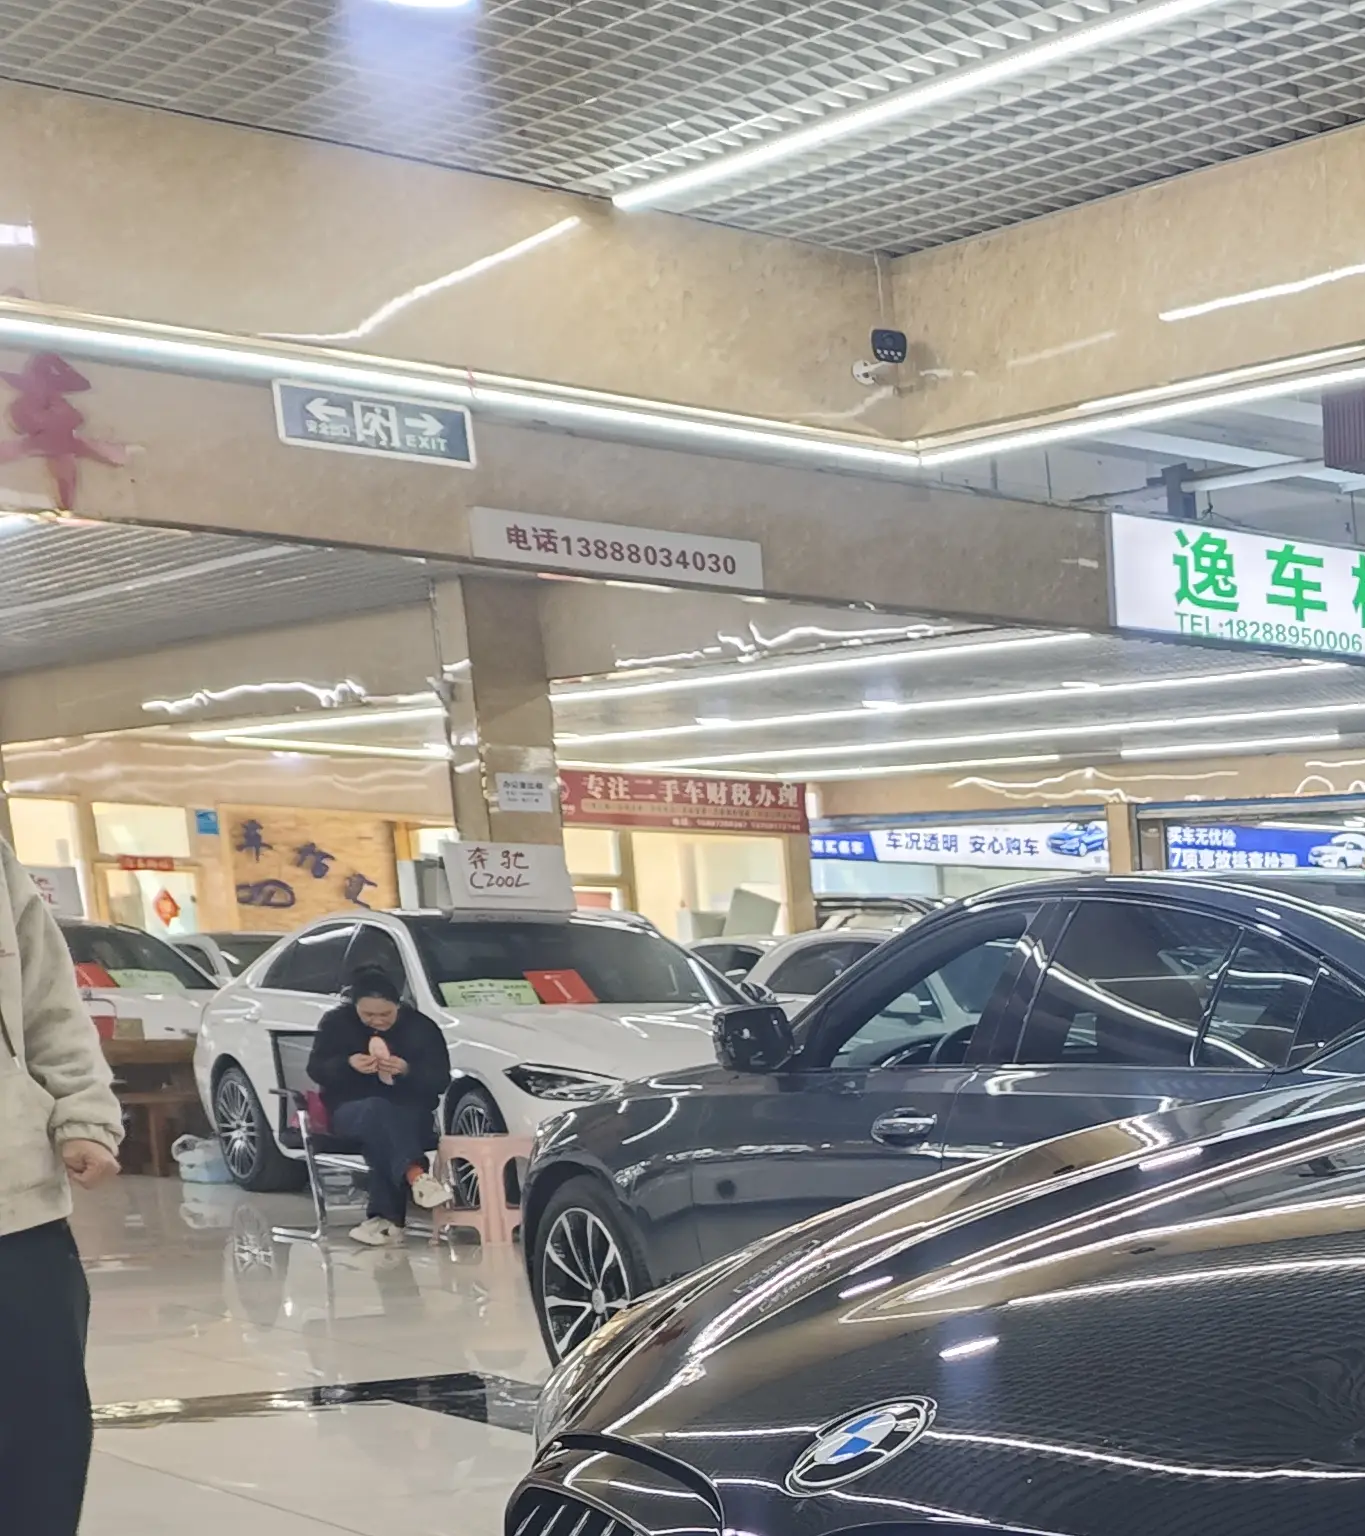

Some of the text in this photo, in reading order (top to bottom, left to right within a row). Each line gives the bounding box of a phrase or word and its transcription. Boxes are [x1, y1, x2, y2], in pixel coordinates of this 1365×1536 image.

[405, 434, 447, 452] EXIT
[505, 523, 737, 576] 电话13888034030
[1174, 611, 1363, 653] TEL:18288950006
[581, 773, 799, 808] 专注二手车财税办理
[886, 831, 959, 853] 车况透明
[968, 834, 1040, 857] 安心购车
